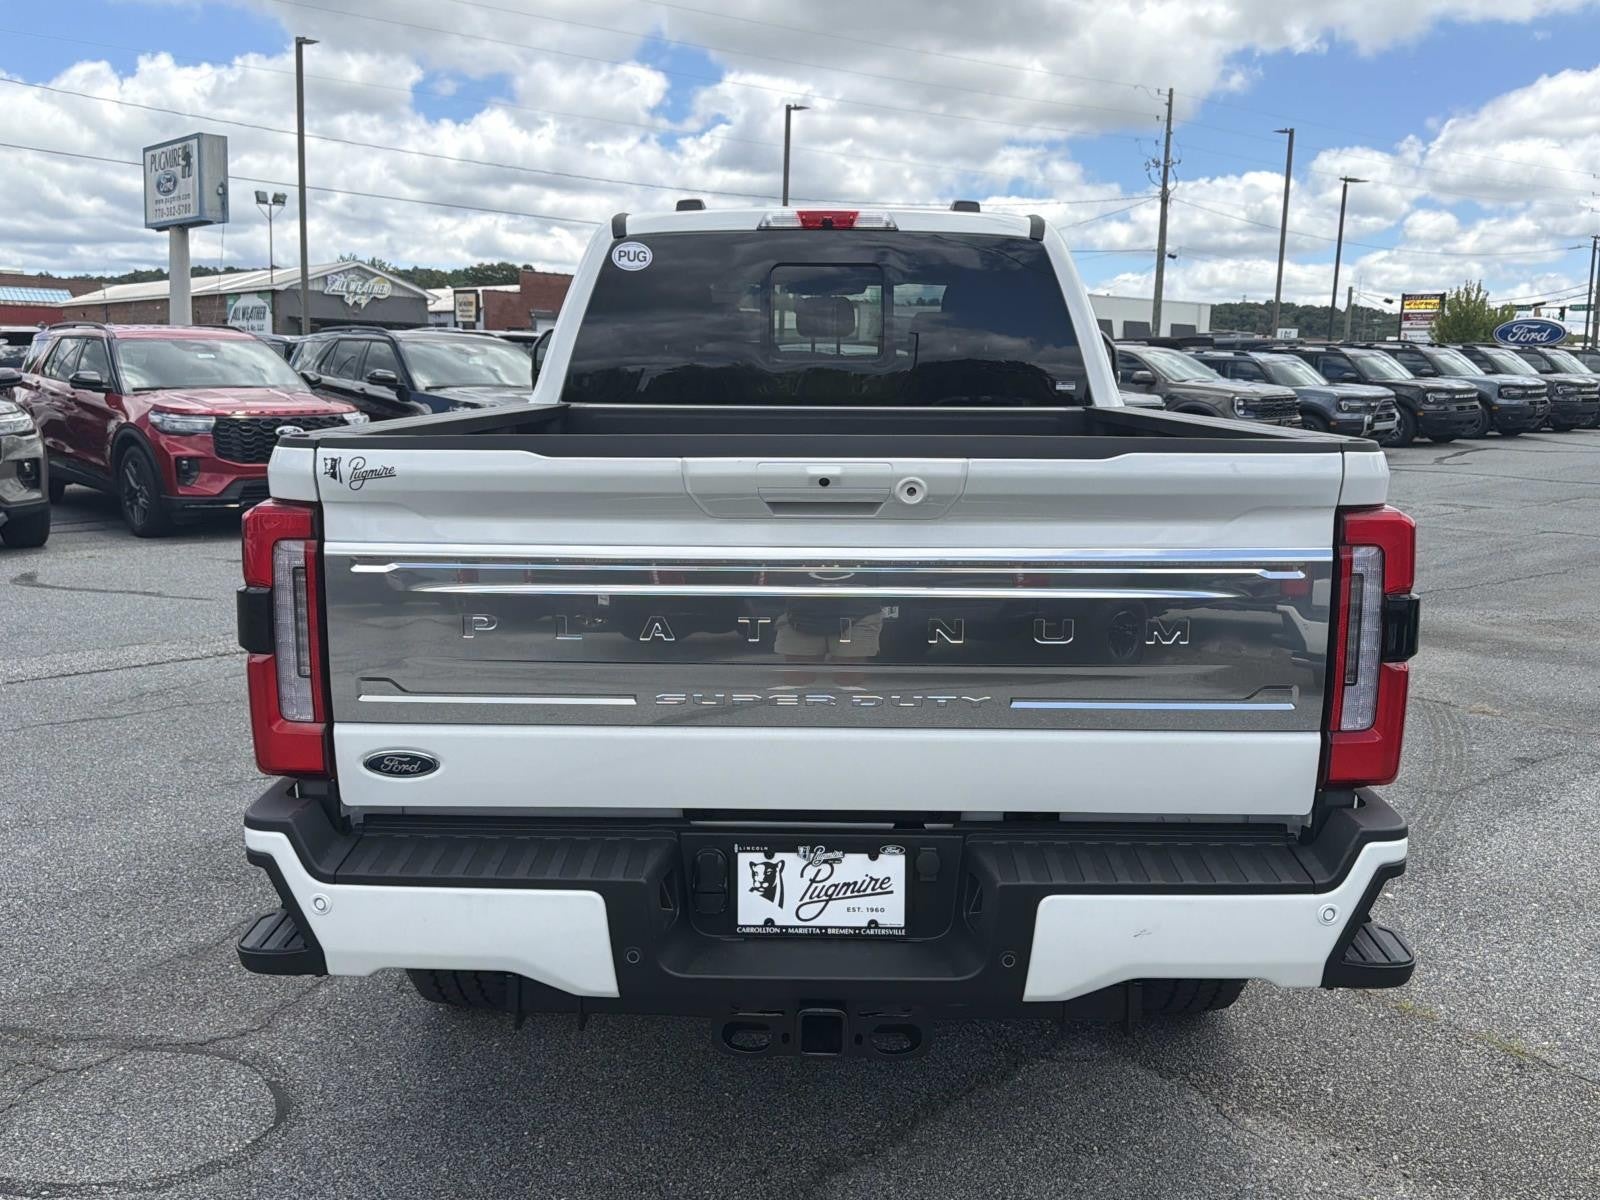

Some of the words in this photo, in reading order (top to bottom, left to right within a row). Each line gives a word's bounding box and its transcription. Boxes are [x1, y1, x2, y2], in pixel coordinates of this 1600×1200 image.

[150, 147, 182, 173] PUGMIRE
[618, 250, 647, 262] PUG
[329, 278, 347, 292] ALL
[348, 280, 389, 294] WEATHER
[230, 307, 240, 323] ALL
[242, 306, 267, 322] WEATHER
[1507, 324, 1551, 343] Ford
[349, 456, 397, 491] Pugmire
[462, 613, 1191, 646] PLATINUM
[655, 693, 837, 706] SUPER
[852, 695, 992, 708] DUTY
[380, 756, 421, 773] Ford
[795, 859, 894, 922] Pugmire
[736, 926, 781, 934] CARROLLTON
[787, 927, 821, 935] MARIETTA
[827, 928, 854, 936] BREMEN
[861, 928, 906, 936] CARTERSVILLE
